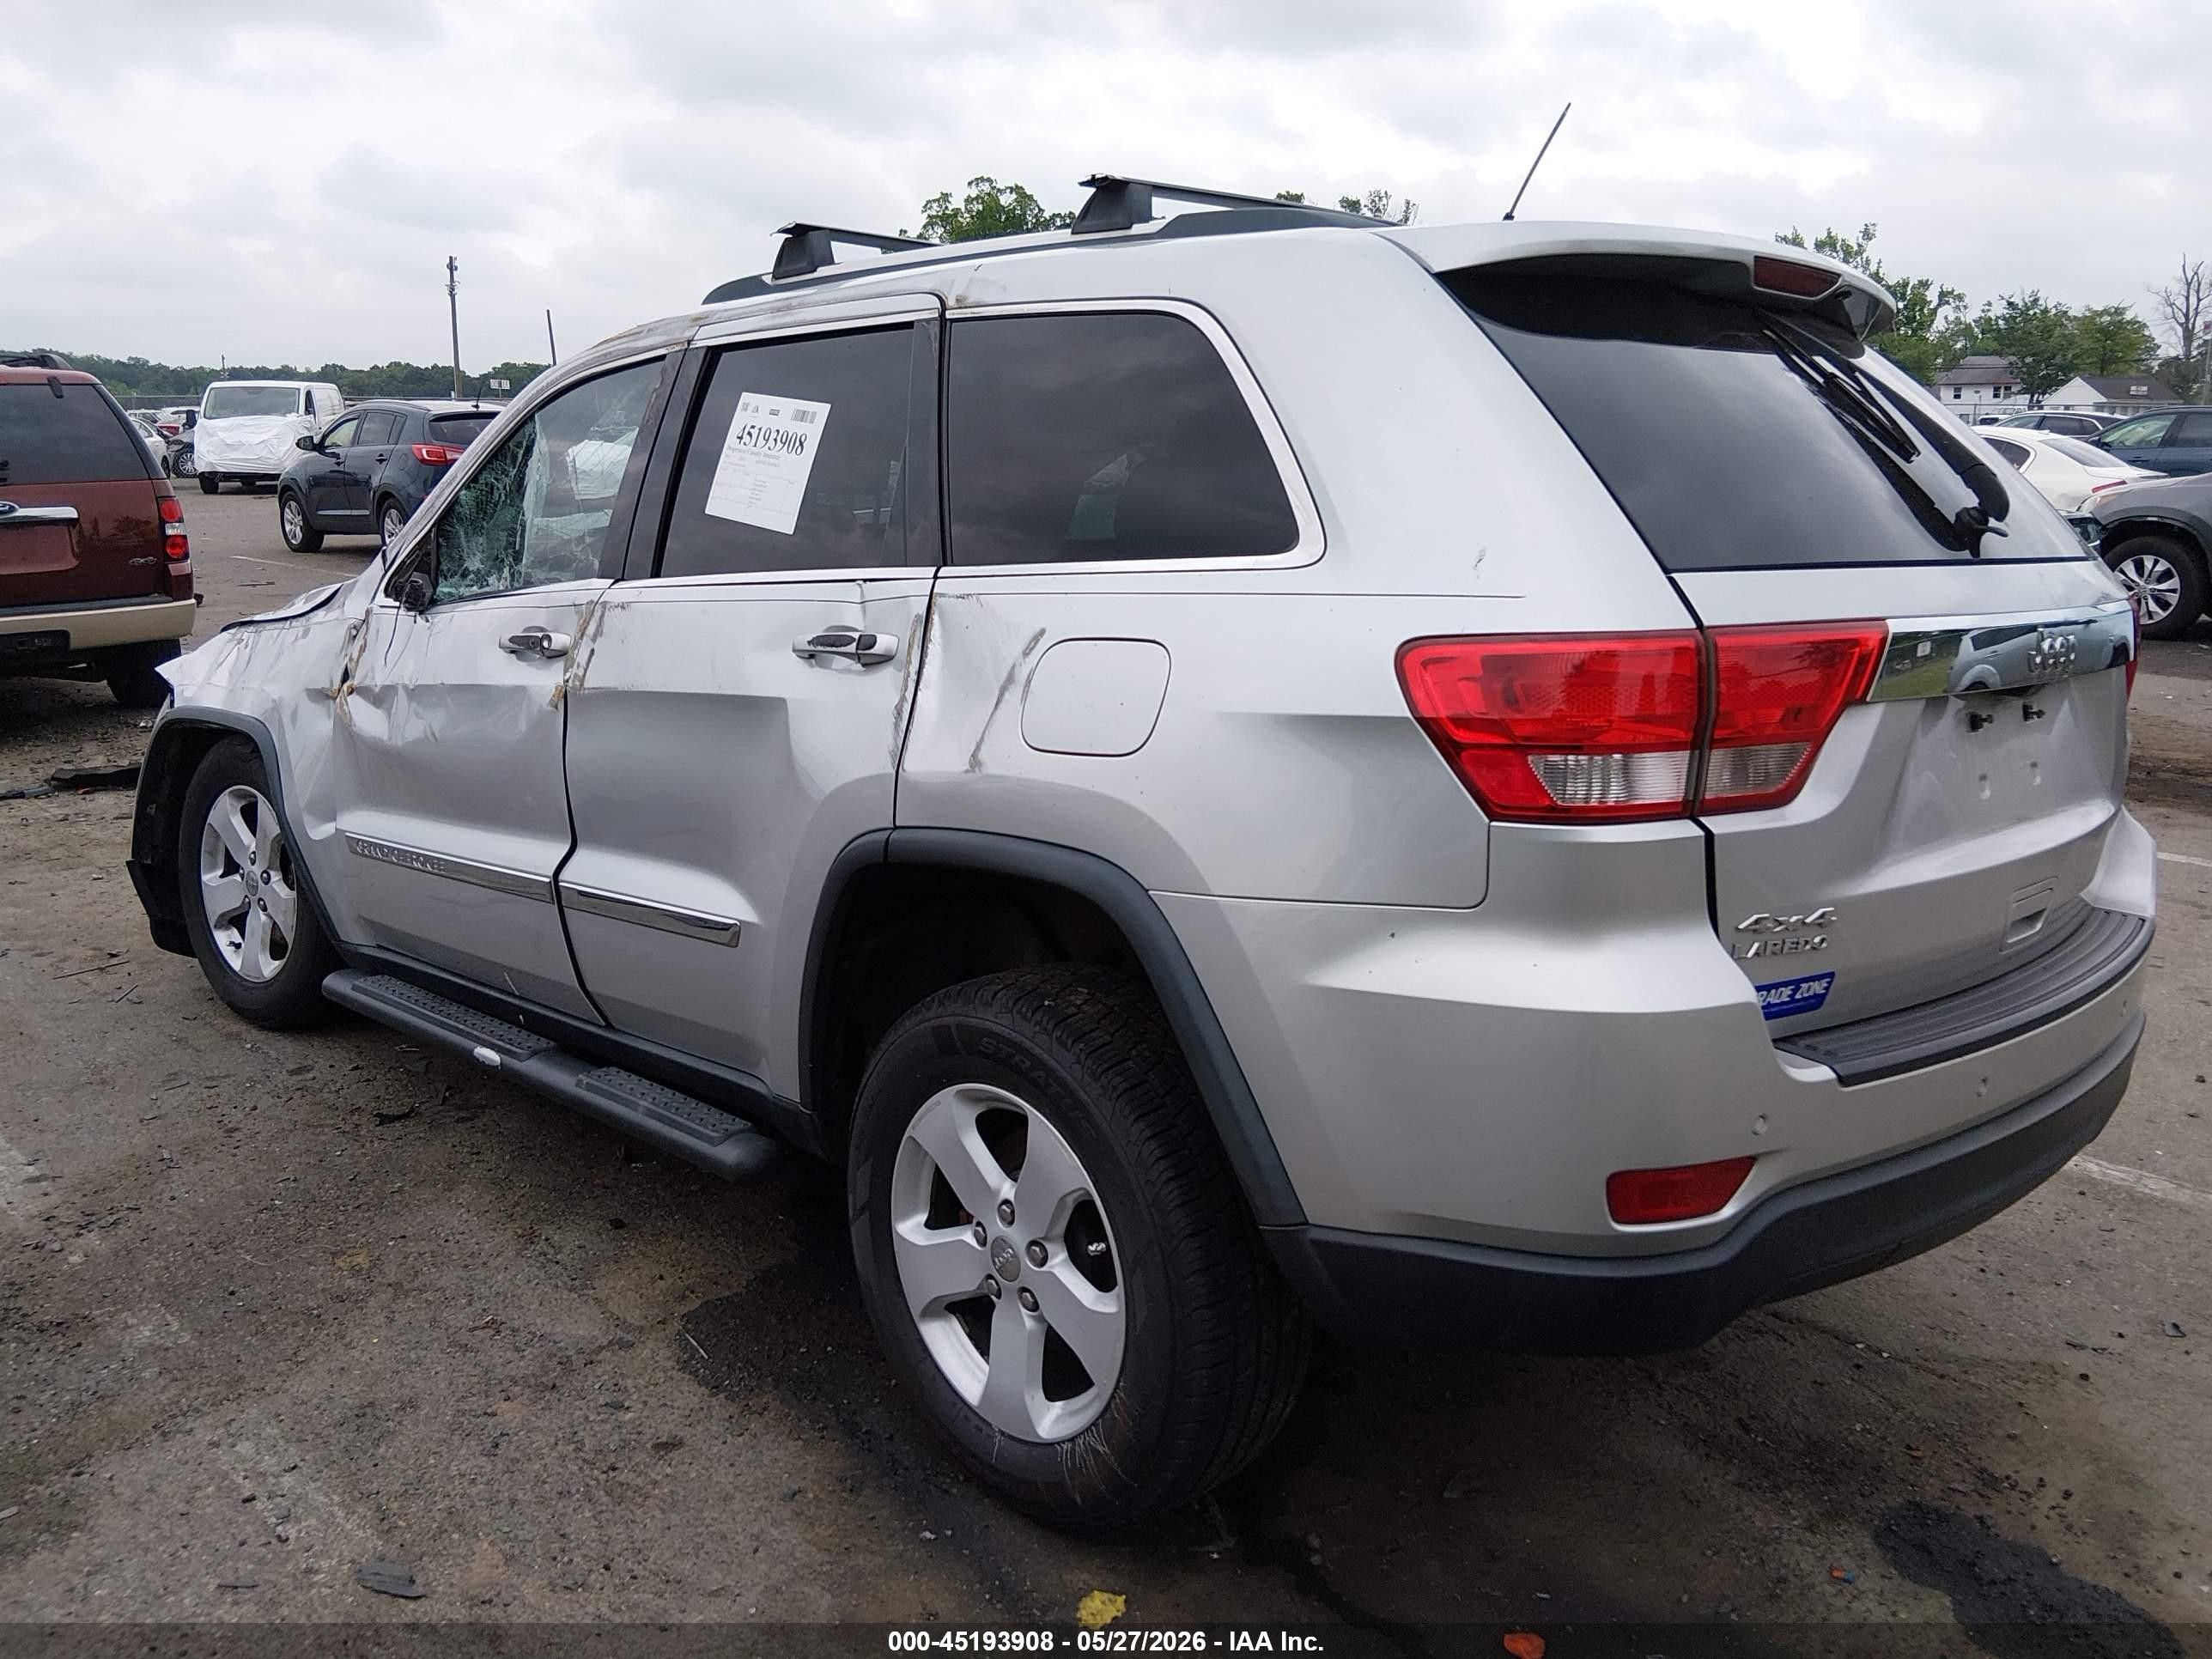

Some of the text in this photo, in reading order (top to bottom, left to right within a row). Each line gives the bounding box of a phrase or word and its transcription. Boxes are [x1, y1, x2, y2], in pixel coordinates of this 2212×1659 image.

[736, 423, 807, 456] 45193908
[2027, 626, 2078, 677] Jeep
[1730, 934, 1828, 960] LAREDO
[1758, 985, 1796, 1006] RADE
[1794, 978, 1832, 999] ZONE
